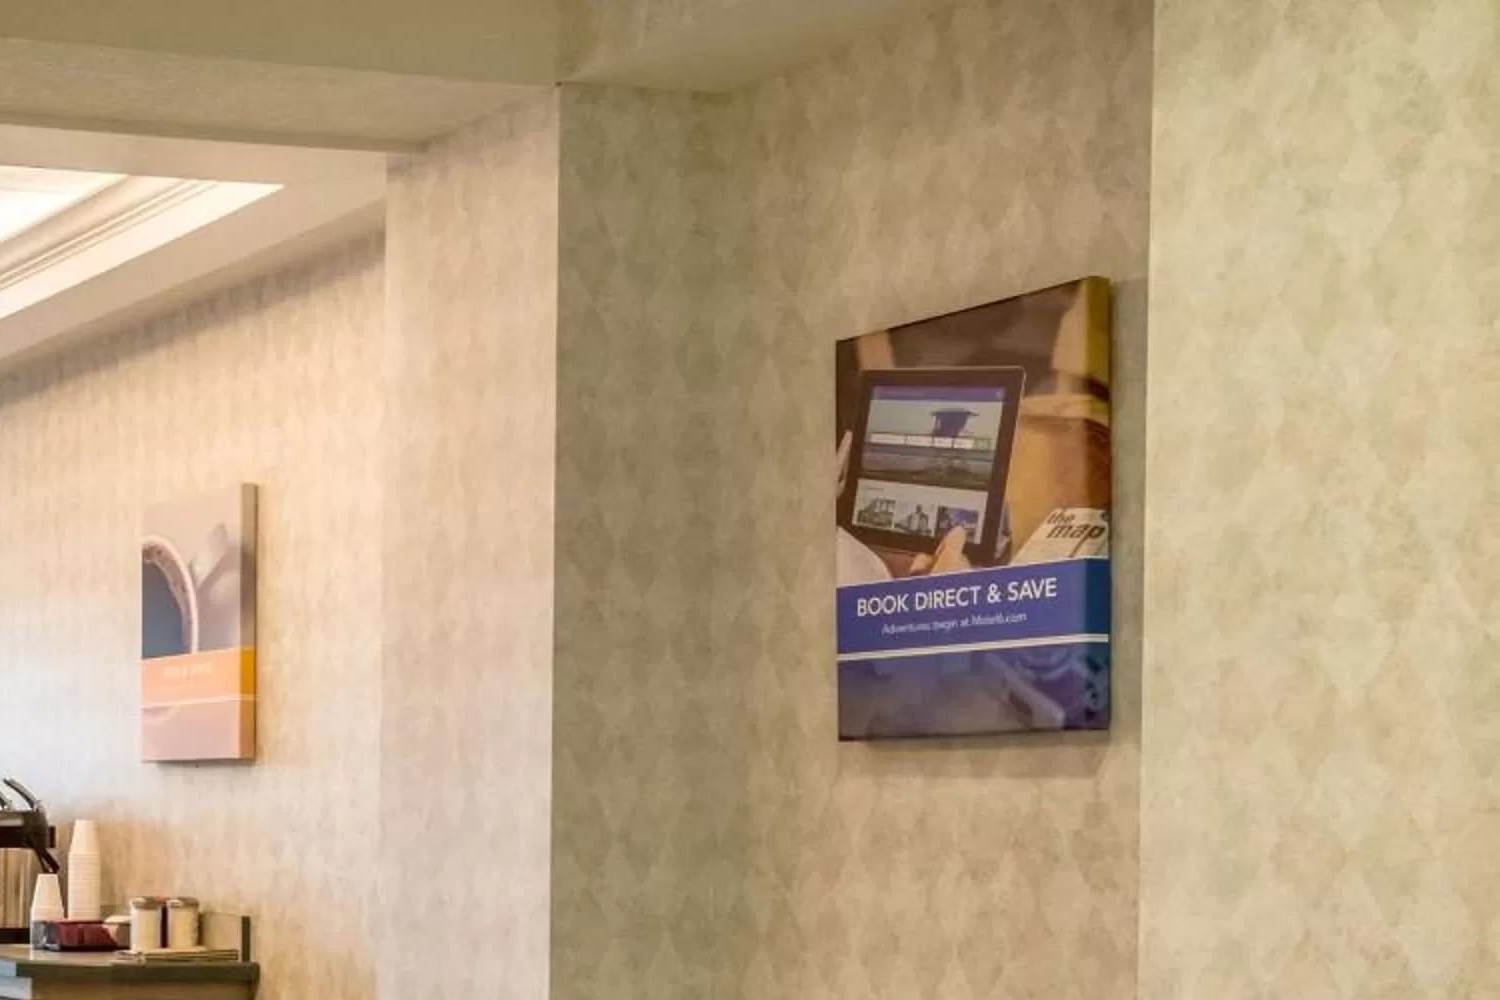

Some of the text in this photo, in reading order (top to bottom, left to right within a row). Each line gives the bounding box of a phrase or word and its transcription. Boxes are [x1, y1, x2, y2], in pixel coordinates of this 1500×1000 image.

[1046, 507, 1076, 525] the
[1046, 524, 1106, 544] map
[857, 577, 1057, 616] BOOK DIRECT & SAVE
